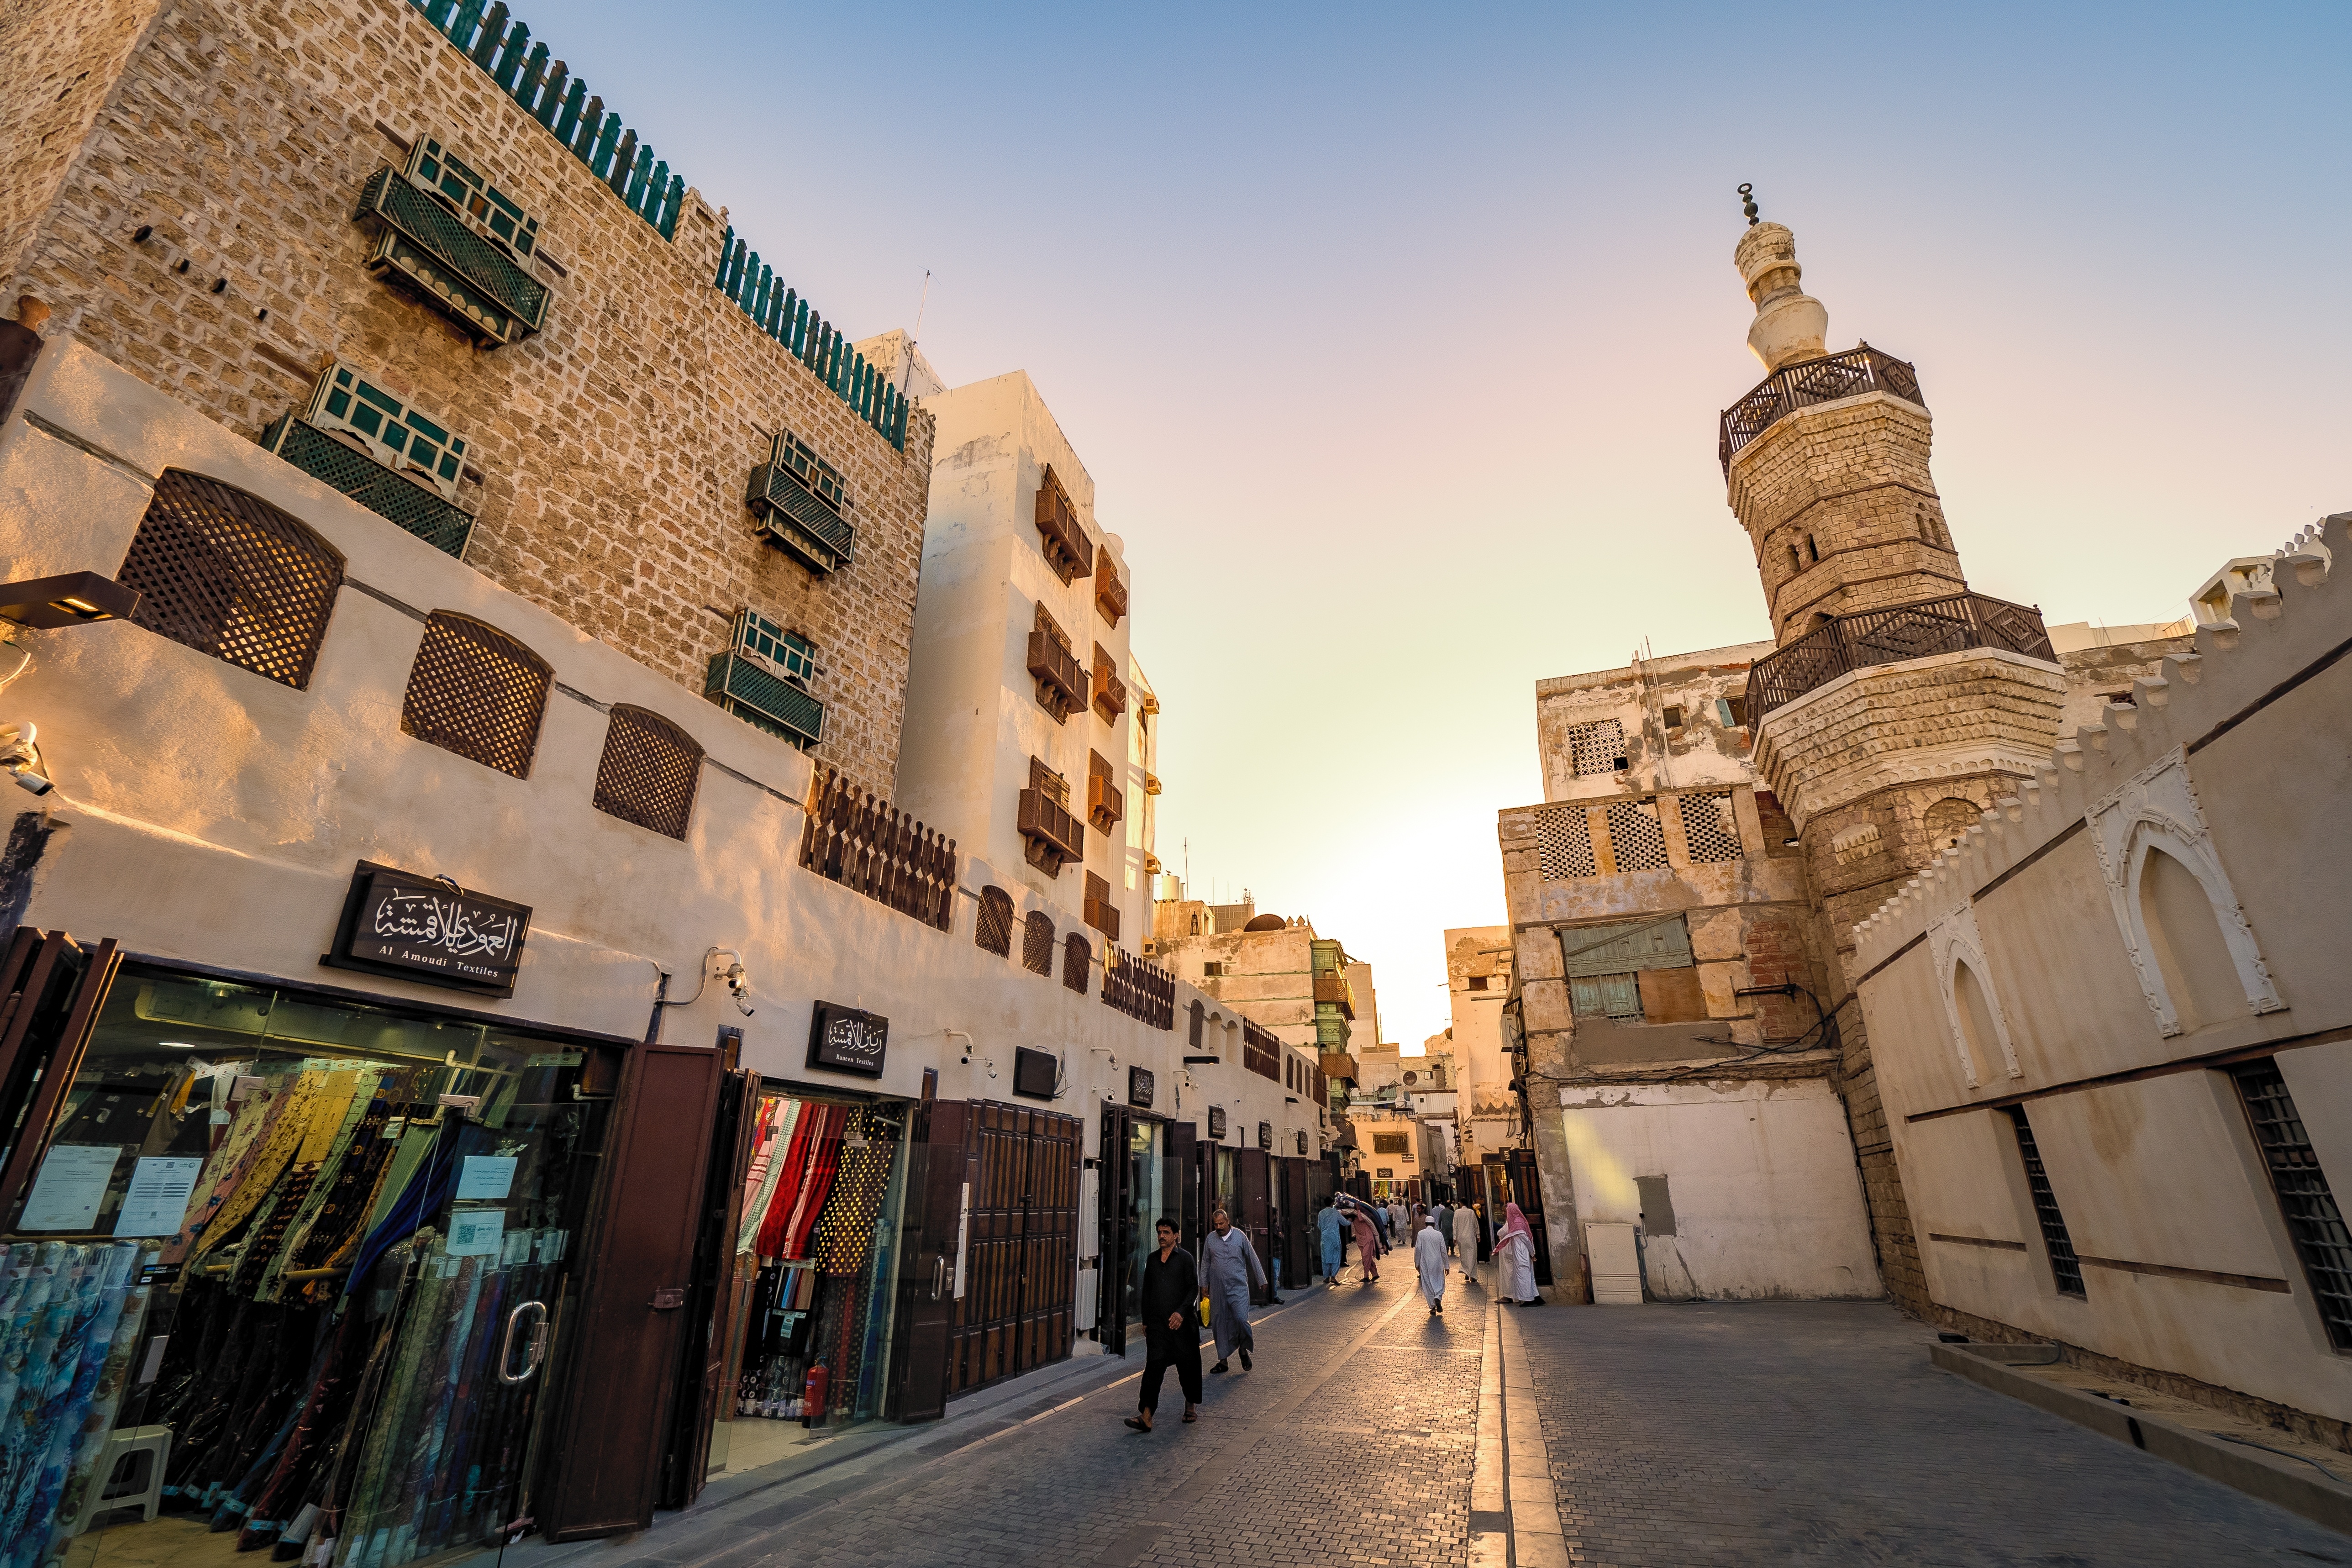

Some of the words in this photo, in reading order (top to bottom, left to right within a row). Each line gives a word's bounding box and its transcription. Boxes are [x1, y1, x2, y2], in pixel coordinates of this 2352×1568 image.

[379, 946, 393, 955] Al
[401, 950, 447, 967] Amoudi
[457, 962, 498, 977] Textiles
[836, 1054, 853, 1063] Raneen
[856, 1058, 874, 1066] Textiles
